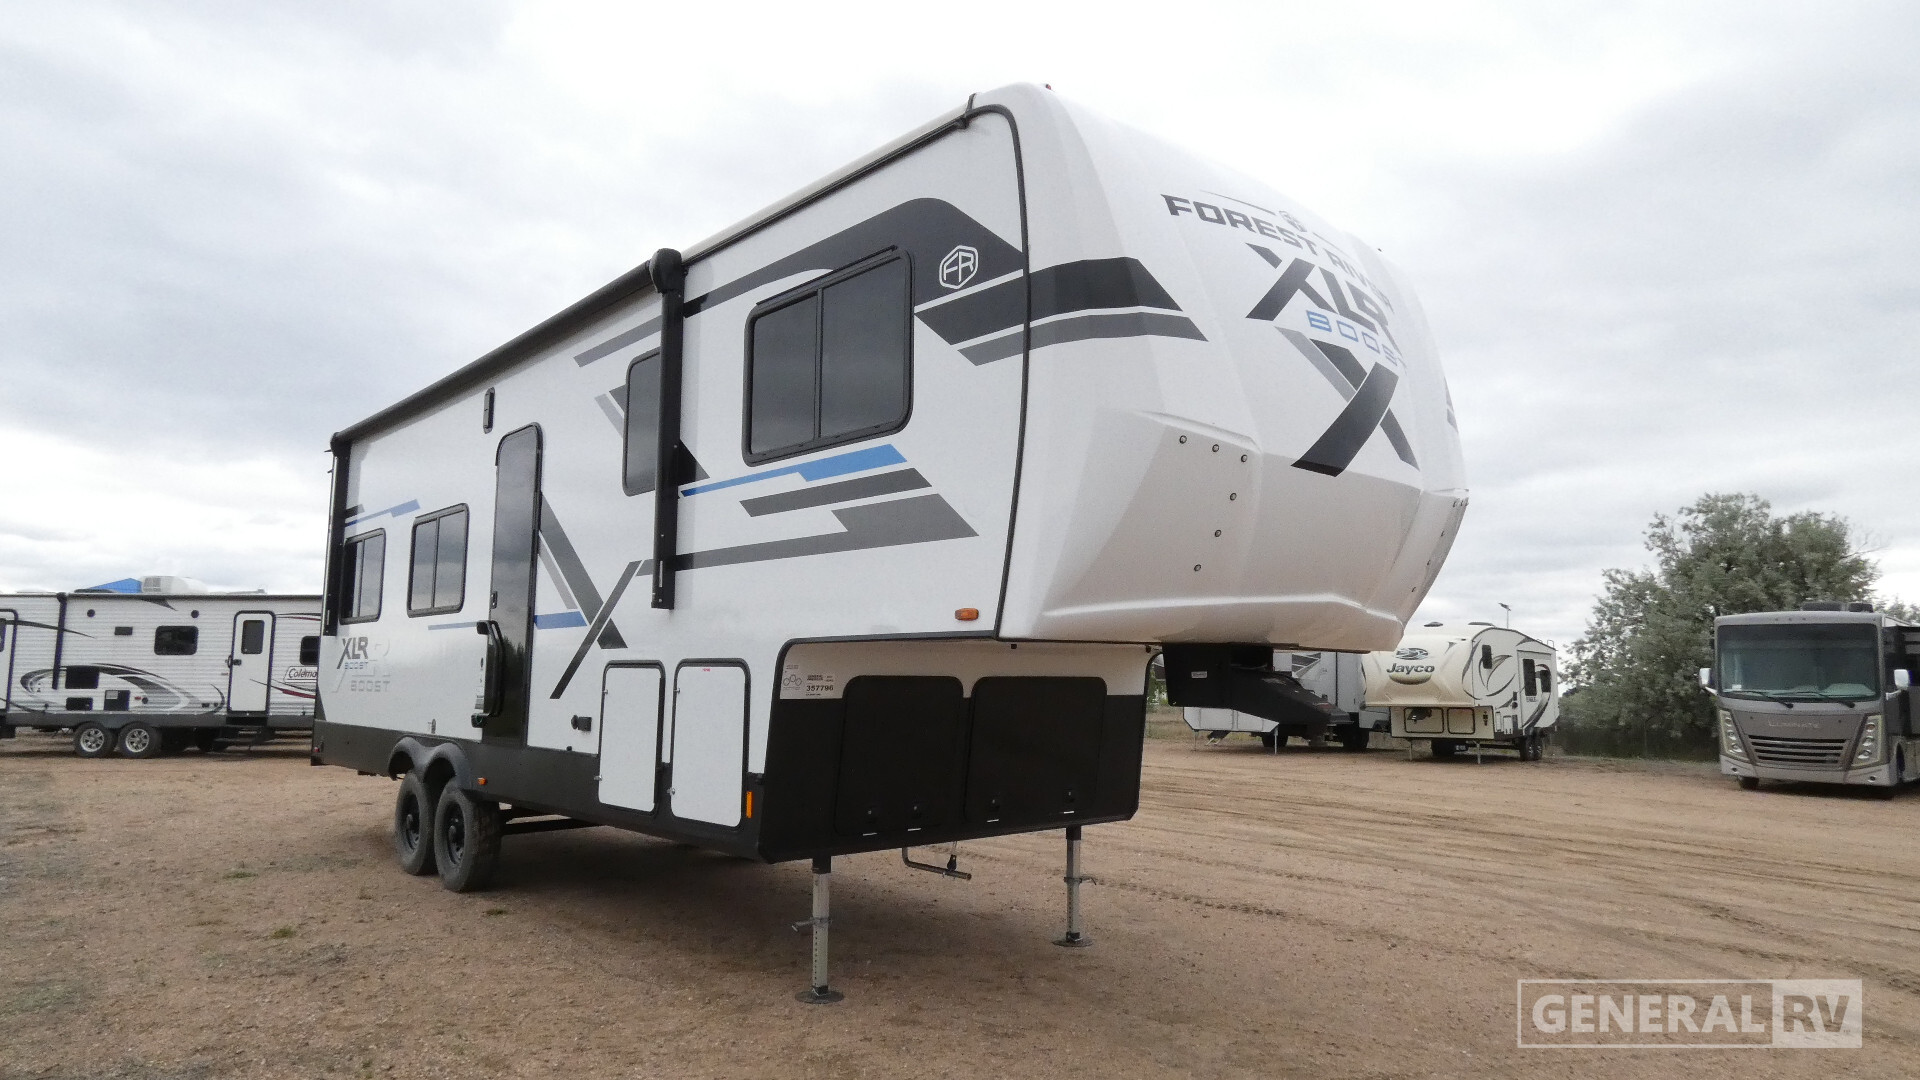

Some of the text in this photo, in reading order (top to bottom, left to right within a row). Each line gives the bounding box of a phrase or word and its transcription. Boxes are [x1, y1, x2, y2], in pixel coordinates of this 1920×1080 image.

[1160, 193, 1318, 256] FOREST
[1245, 242, 1403, 358] XLR
[1306, 310, 1408, 375] BOOST
[337, 637, 369, 669] XLR
[1386, 663, 1435, 675] Jayco
[288, 668, 317, 679] Colema
[351, 680, 391, 692] BOOST
